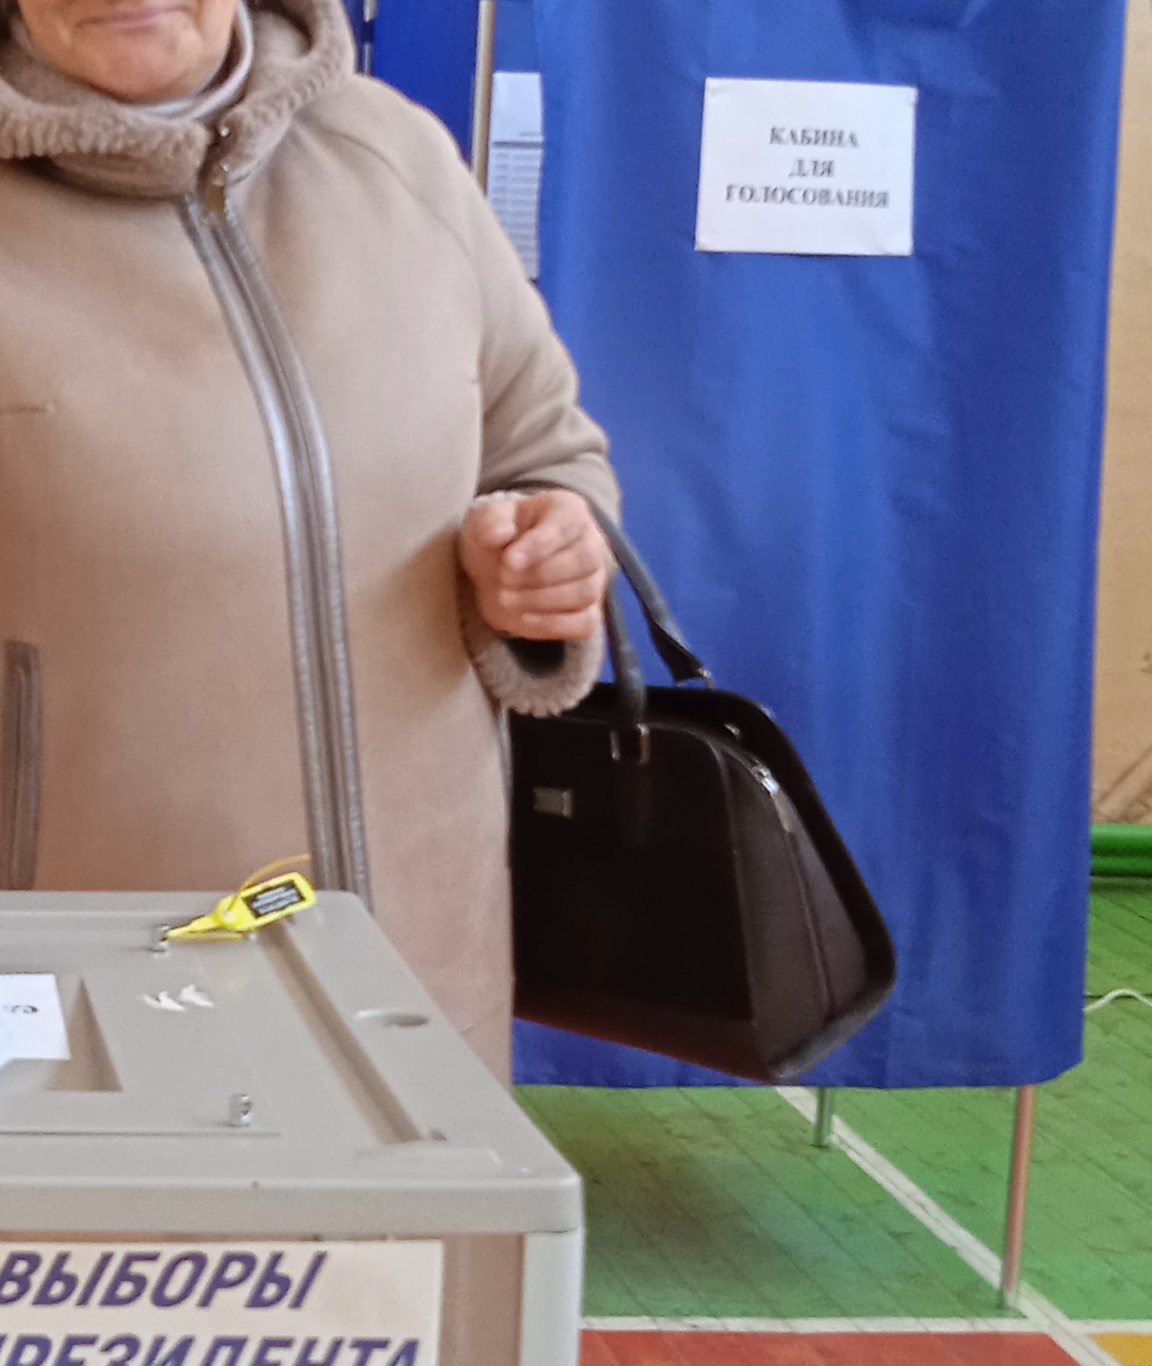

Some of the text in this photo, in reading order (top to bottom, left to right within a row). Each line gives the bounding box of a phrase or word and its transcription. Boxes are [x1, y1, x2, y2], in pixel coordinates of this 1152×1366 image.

[768, 126, 859, 149] КАБИНА
[788, 157, 835, 178] ДЛЯ
[725, 184, 890, 209] ГОЛОСОВАНИЯ
